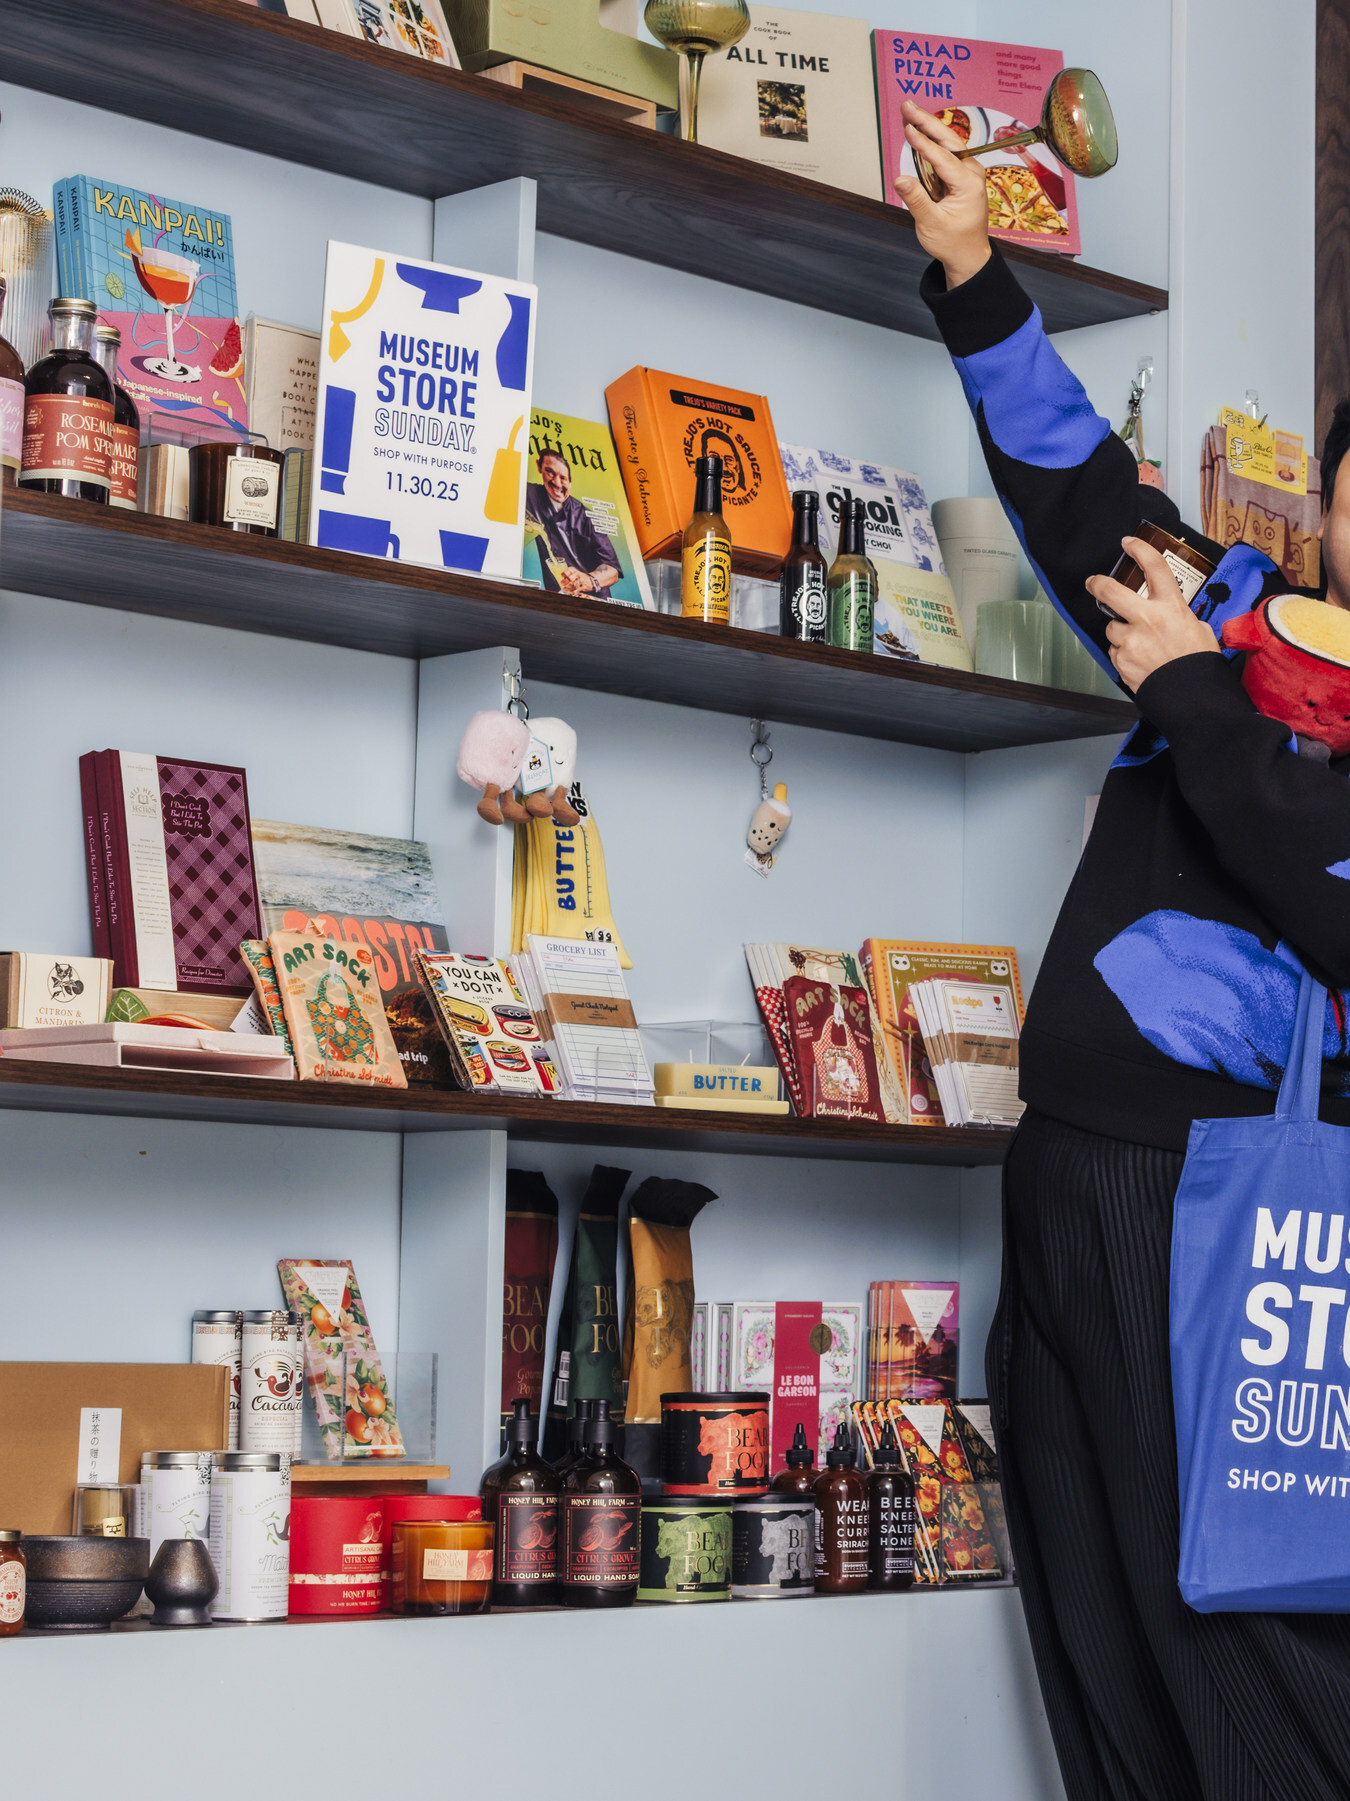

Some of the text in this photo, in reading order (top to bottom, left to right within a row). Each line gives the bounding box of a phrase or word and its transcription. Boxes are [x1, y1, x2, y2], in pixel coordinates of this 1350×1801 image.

[893, 38, 971, 60] SALAD
[726, 46, 830, 72] ALL TIME
[1014, 54, 1036, 62] many
[894, 58, 956, 80] PIZZA
[996, 60, 1041, 72] more good
[997, 70, 1022, 79] things
[896, 78, 952, 100] WINE
[998, 79, 1042, 91] from Elena
[94, 187, 224, 247] KANPAI!
[379, 330, 479, 377] MUSEUM
[283, 392, 306, 404] BOOK
[376, 365, 478, 420] STORE
[56, 432, 90, 450] POM
[684, 417, 762, 484] TREJO'S HOT SAUCE
[374, 447, 474, 474] SHOP WITH PURPOSE
[386, 472, 459, 501] 11.30.25
[722, 488, 758, 506] PICANTE
[870, 540, 892, 550] CHOI
[894, 593, 918, 606] THAT
[900, 606, 956, 626] YOU WHERE
[918, 620, 962, 638] YOU ARE.
[132, 806, 156, 815] SECTION
[546, 943, 607, 957] GROCERY LIST
[284, 943, 372, 988] ART SACK
[442, 966, 502, 983] YOU CAN
[461, 981, 494, 994] DO IT
[796, 988, 824, 1016] ART
[830, 988, 866, 1028] SACK
[952, 996, 982, 1008] Recipe
[38, 1007, 82, 1018] CITRON &
[412, 1052, 428, 1065] trip
[314, 1064, 355, 1080] Christine
[694, 1075, 762, 1092] BUTTER
[817, 1102, 878, 1120] Christine Schmidt
[781, 1375, 813, 1386] LE BON
[252, 1399, 294, 1411] Cacao
[1227, 1468, 1296, 1492] SHOP
[509, 1497, 544, 1506] HONEY HILL
[571, 1498, 626, 1507] HONEY HILL FARM
[880, 1497, 916, 1509] BEES
[880, 1512, 916, 1521] KNEES
[344, 1555, 366, 1564] CITRUS
[433, 1552, 458, 1560] HONEY
[514, 1552, 546, 1561] CITRUS
[576, 1553, 635, 1563] CITRUS GROVE
[444, 1559, 464, 1568] FARM
[512, 1572, 540, 1580] LIQUID
[574, 1574, 600, 1582] LIQUID
[342, 1590, 366, 1600] HONEY
